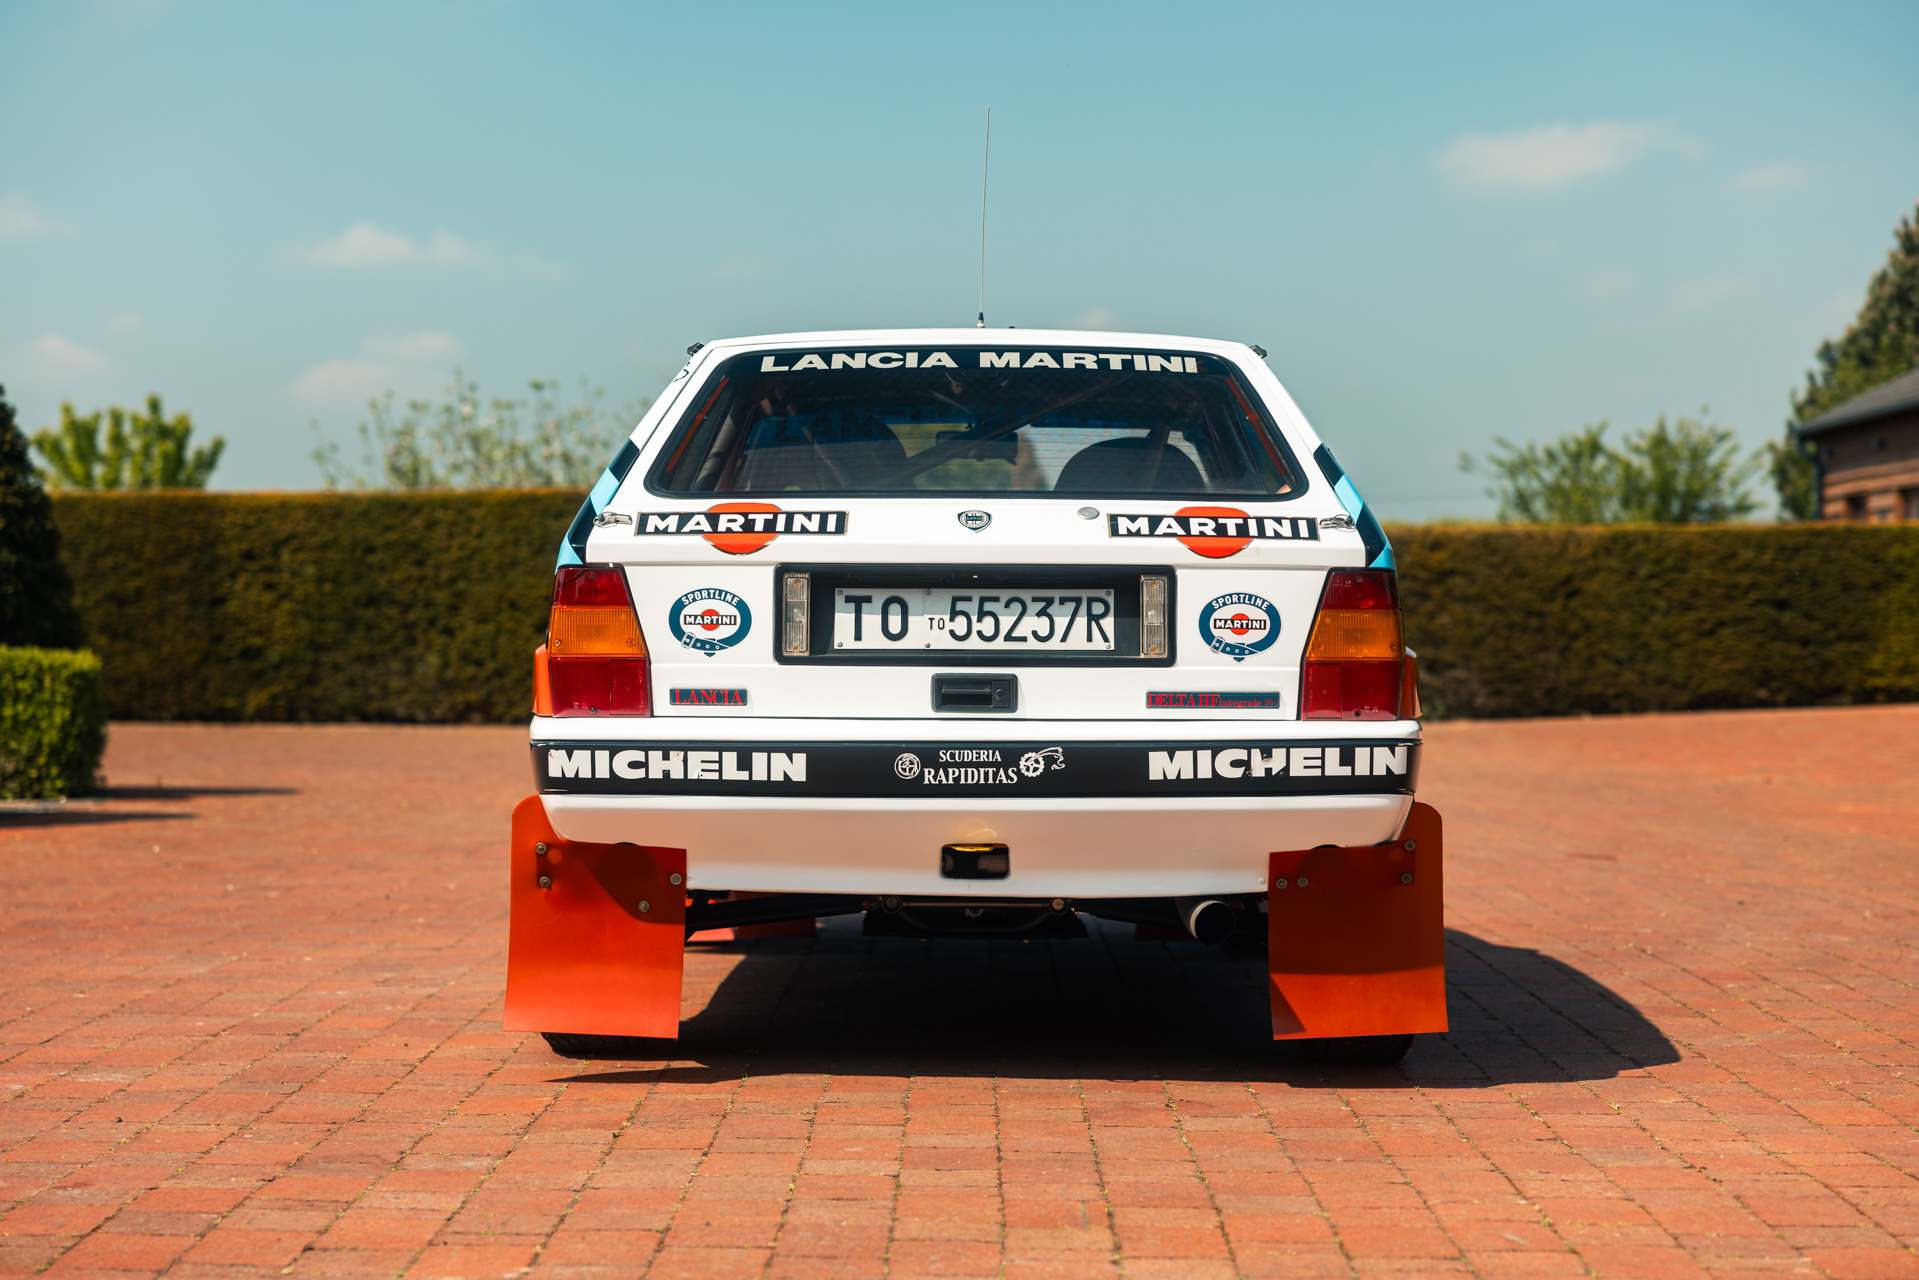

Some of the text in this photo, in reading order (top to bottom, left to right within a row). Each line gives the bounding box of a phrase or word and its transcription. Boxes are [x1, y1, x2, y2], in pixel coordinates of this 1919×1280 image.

[760, 351, 1199, 374] LANCIA MARTINI
[644, 513, 839, 533] MARTINI
[1116, 516, 1311, 539] MARTINI
[681, 589, 740, 606] SPORTLINE
[1211, 594, 1270, 611] SPORTLINE
[685, 615, 735, 625] MARTINI
[843, 594, 910, 642] TO
[948, 594, 1112, 643] 55237R
[1215, 619, 1265, 629] MARTINI
[674, 688, 744, 705] LANCIA
[1148, 693, 1196, 707] DELTA
[939, 749, 1002, 762] SCUDERIA
[1148, 745, 1409, 781] MICHELIN
[547, 748, 808, 783] MICHELIN
[922, 767, 1018, 784] RAPIDITAS
